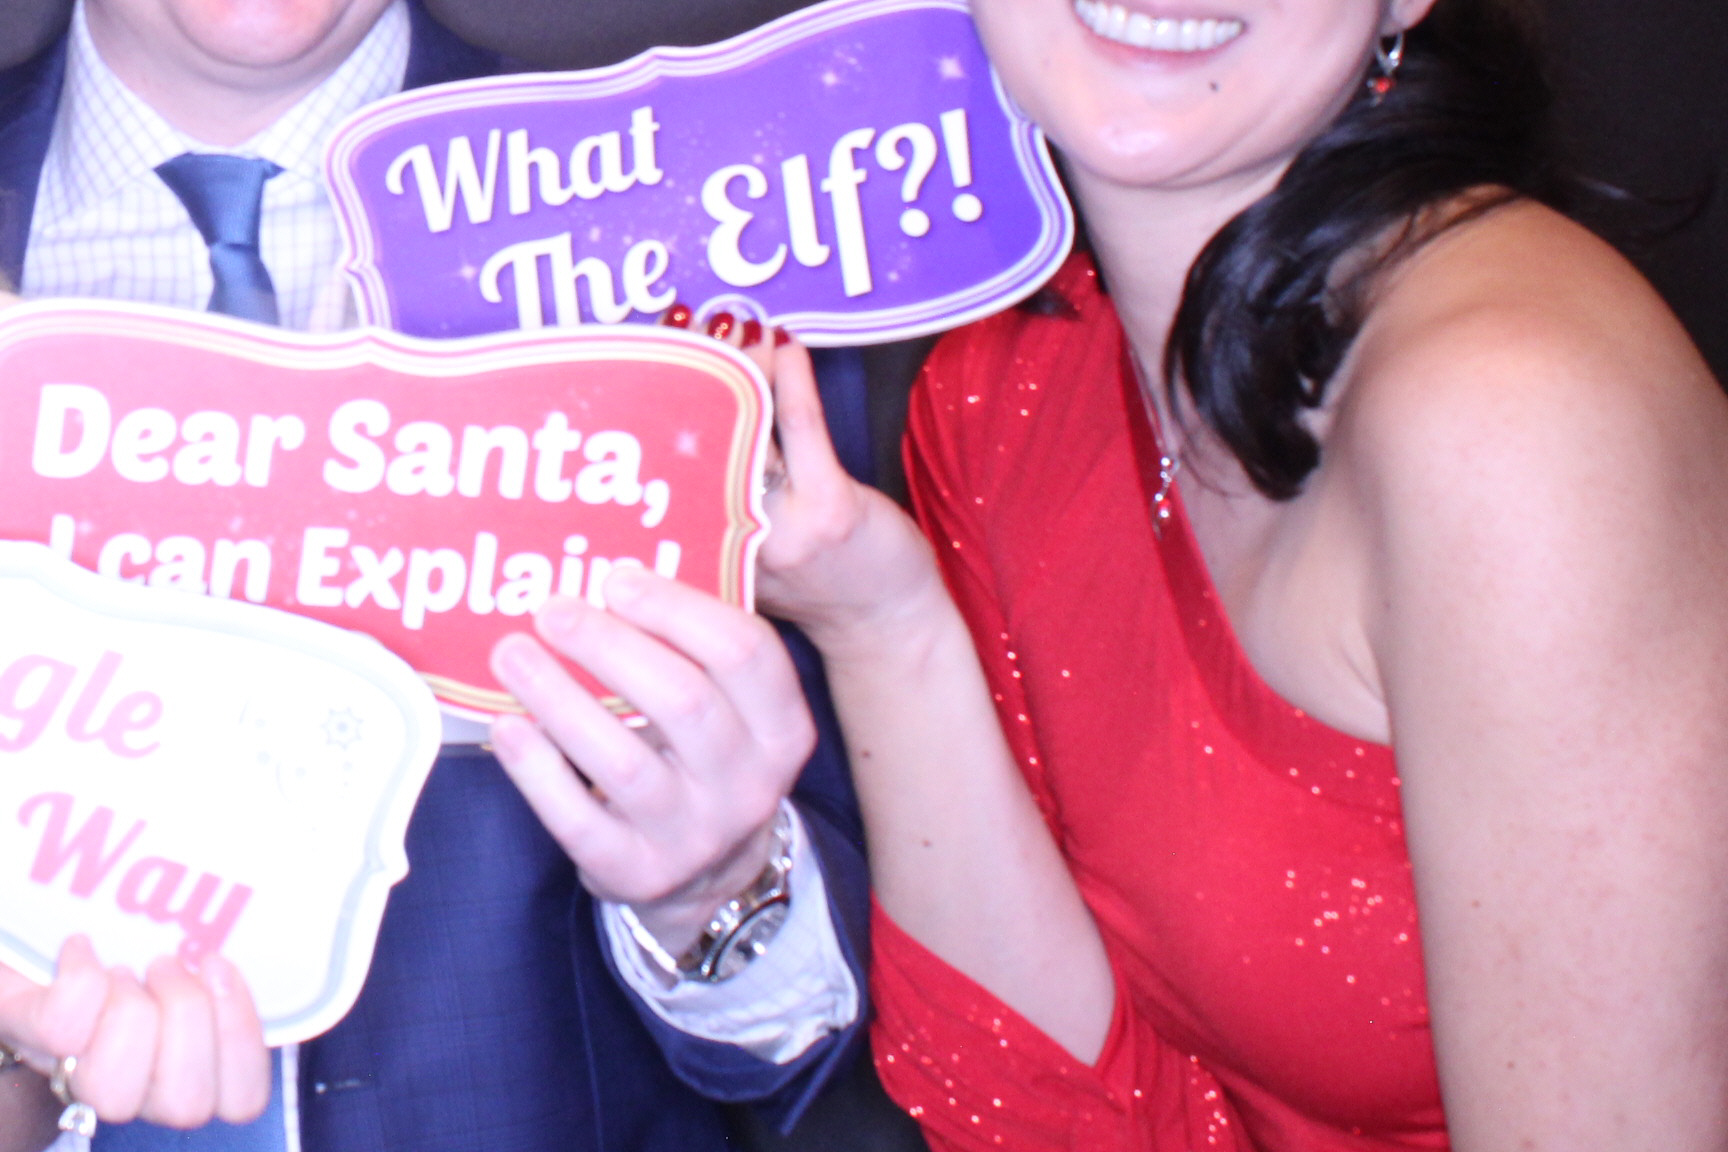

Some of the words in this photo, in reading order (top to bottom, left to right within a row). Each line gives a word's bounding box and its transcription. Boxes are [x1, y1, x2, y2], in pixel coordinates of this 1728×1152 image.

[385, 105, 664, 233] What
[479, 231, 677, 330] The
[700, 108, 984, 298] Elf?!
[32, 383, 305, 489] Dear
[322, 399, 671, 528] Santa,
[98, 532, 271, 604] can
[17, 791, 255, 970] Way
